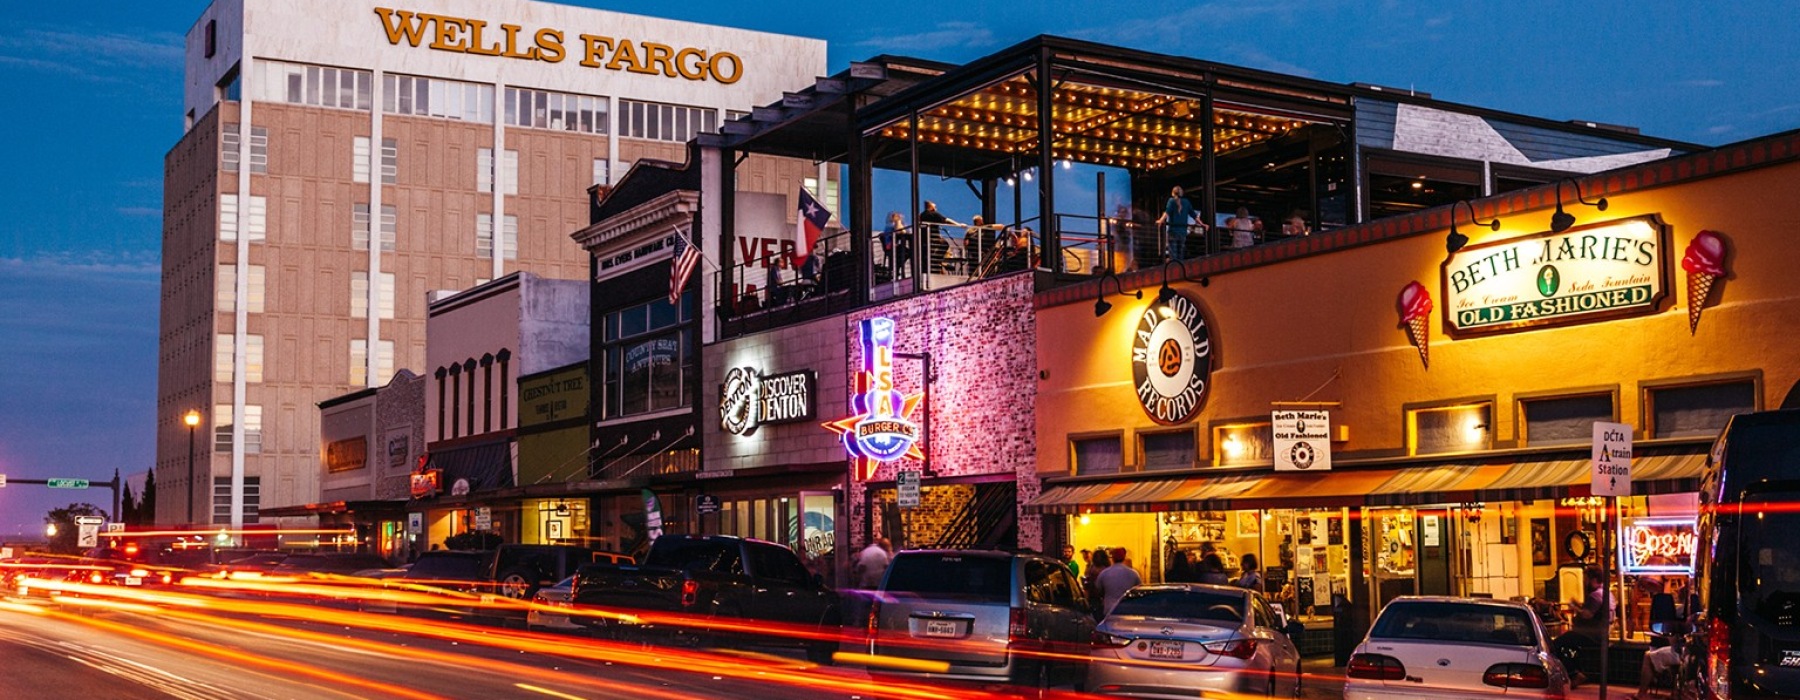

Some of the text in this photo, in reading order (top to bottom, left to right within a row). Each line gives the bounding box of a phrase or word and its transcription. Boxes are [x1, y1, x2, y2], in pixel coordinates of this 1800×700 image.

[375, 7, 744, 84] WELLS FARGO
[1451, 246, 1520, 295] BETH
[1568, 274, 1651, 294] Soda Fountain
[1460, 287, 1649, 326] OLD FASHIONED
[1482, 294, 1518, 306] Cream
[1132, 294, 1210, 363] MAD WORLD
[523, 376, 584, 402] CHESTNUT TREE
[719, 369, 753, 422] DENTON
[758, 373, 807, 399] DISCOVER
[1138, 373, 1205, 421] RECORDS
[757, 392, 807, 422] DENTON
[1297, 412, 1327, 420] Marie's
[860, 421, 900, 436] BURGER
[1603, 430, 1625, 442] DCTA
[1598, 464, 1629, 476] Station
